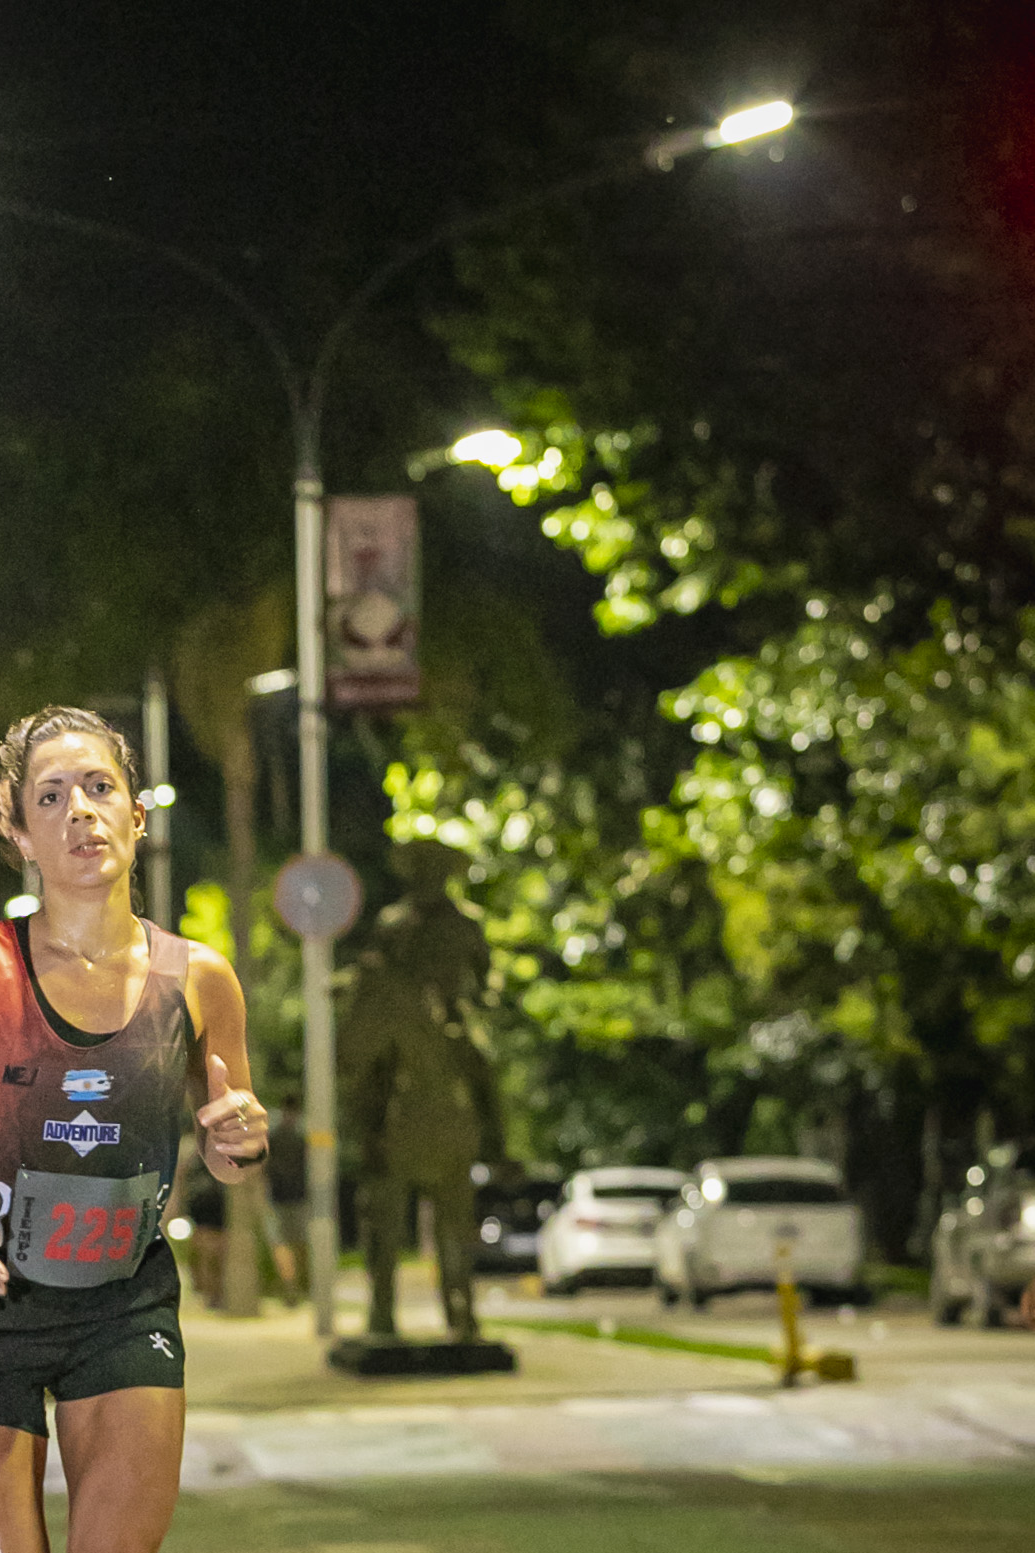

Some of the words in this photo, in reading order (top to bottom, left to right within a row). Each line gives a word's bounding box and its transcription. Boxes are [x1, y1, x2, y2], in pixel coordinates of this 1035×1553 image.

[45, 1122, 118, 1142] ADVENTURE
[16, 1196, 35, 1261] TIEMPO
[44, 1202, 137, 1262] 225
